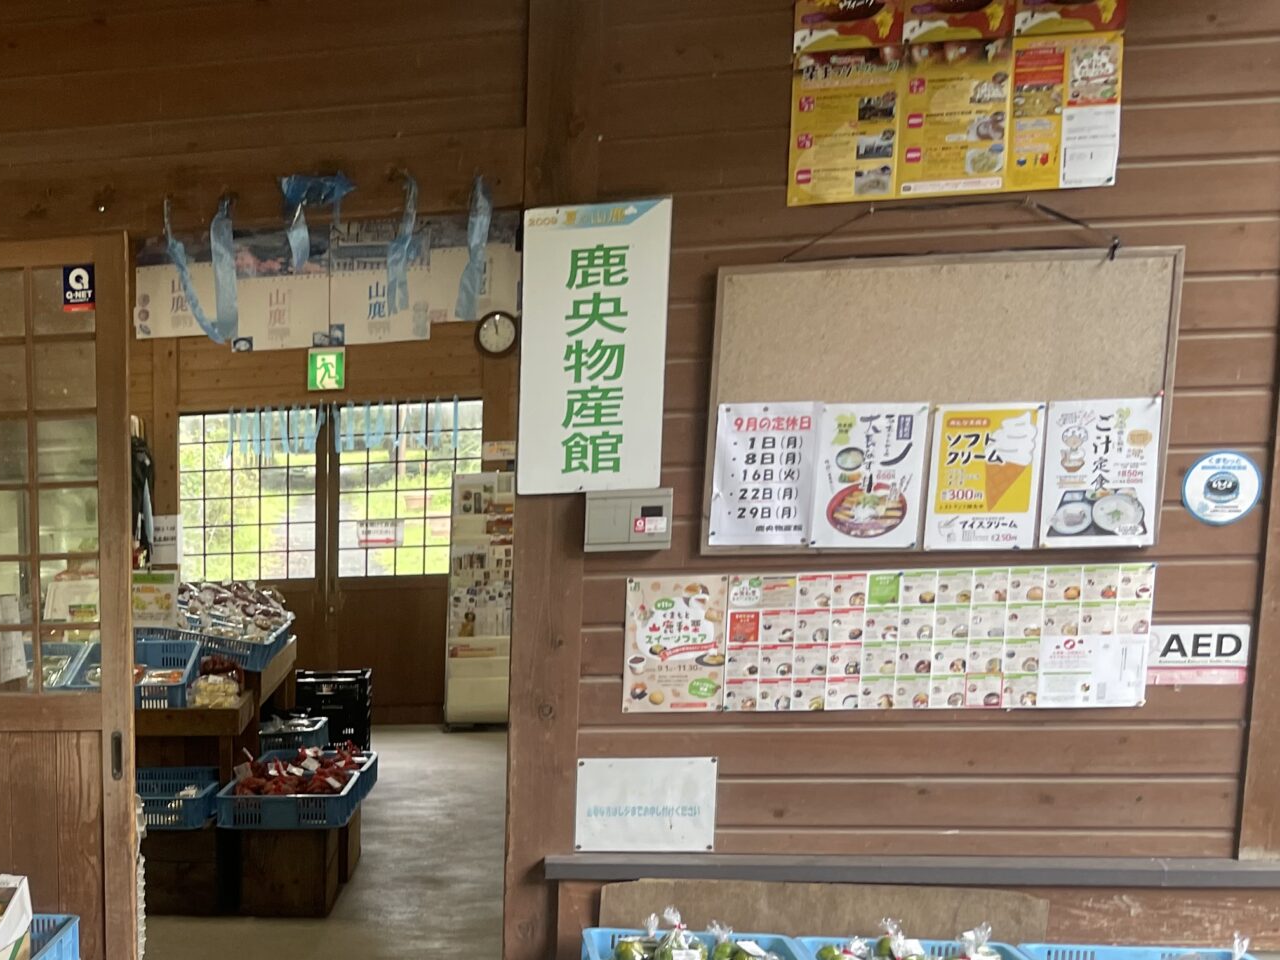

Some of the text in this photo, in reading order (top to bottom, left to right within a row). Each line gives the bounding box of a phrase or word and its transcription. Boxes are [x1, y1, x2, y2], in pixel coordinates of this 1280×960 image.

[367, 280, 387, 321] 山鹿
[561, 244, 631, 474] 鹿央物産館
[733, 415, 812, 432] 9月の定休日
[946, 432, 997, 448] ソフト
[946, 449, 1004, 466] クリーム
[959, 519, 1018, 530] アイスクリーム
[645, 633, 708, 645] スイーツフェア
[1159, 633, 1243, 658] AED
